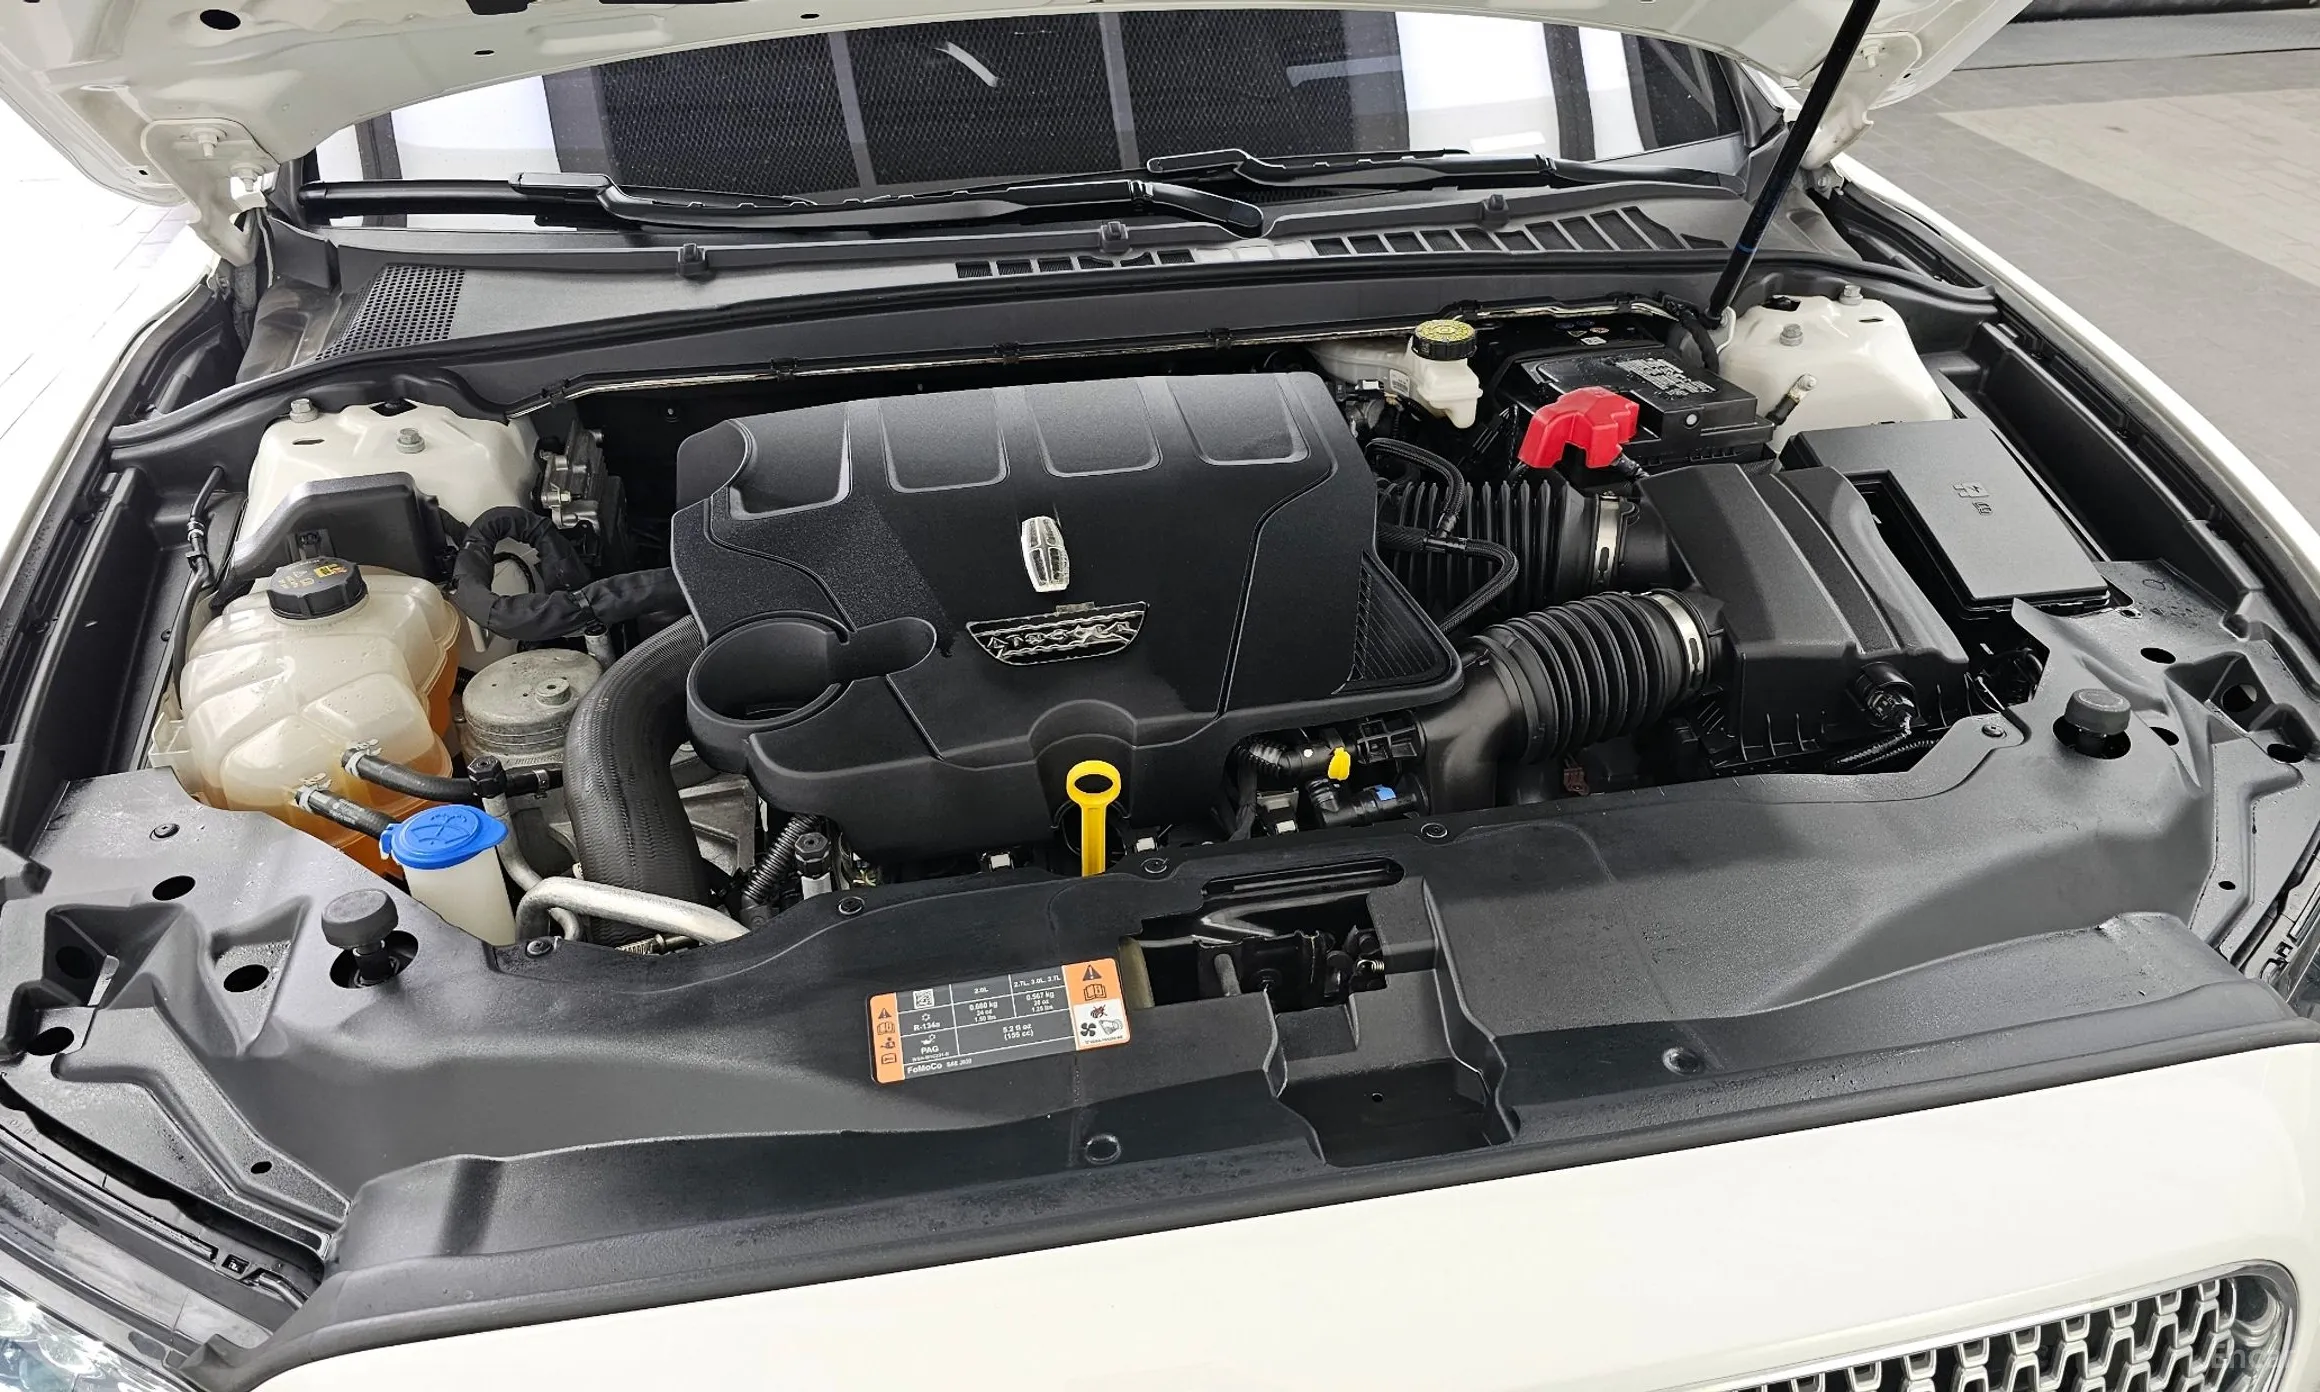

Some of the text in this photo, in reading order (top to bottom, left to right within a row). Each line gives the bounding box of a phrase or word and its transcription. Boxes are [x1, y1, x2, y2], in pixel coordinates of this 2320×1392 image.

[1026, 991, 1055, 1001] 0.567 kg
[988, 1001, 998, 1009] kg
[913, 1021, 941, 1032] R-134a
[1002, 1025, 1014, 1034] 5.2
[920, 1045, 940, 1055] PAG
[906, 1062, 943, 1074] FoMoCo
